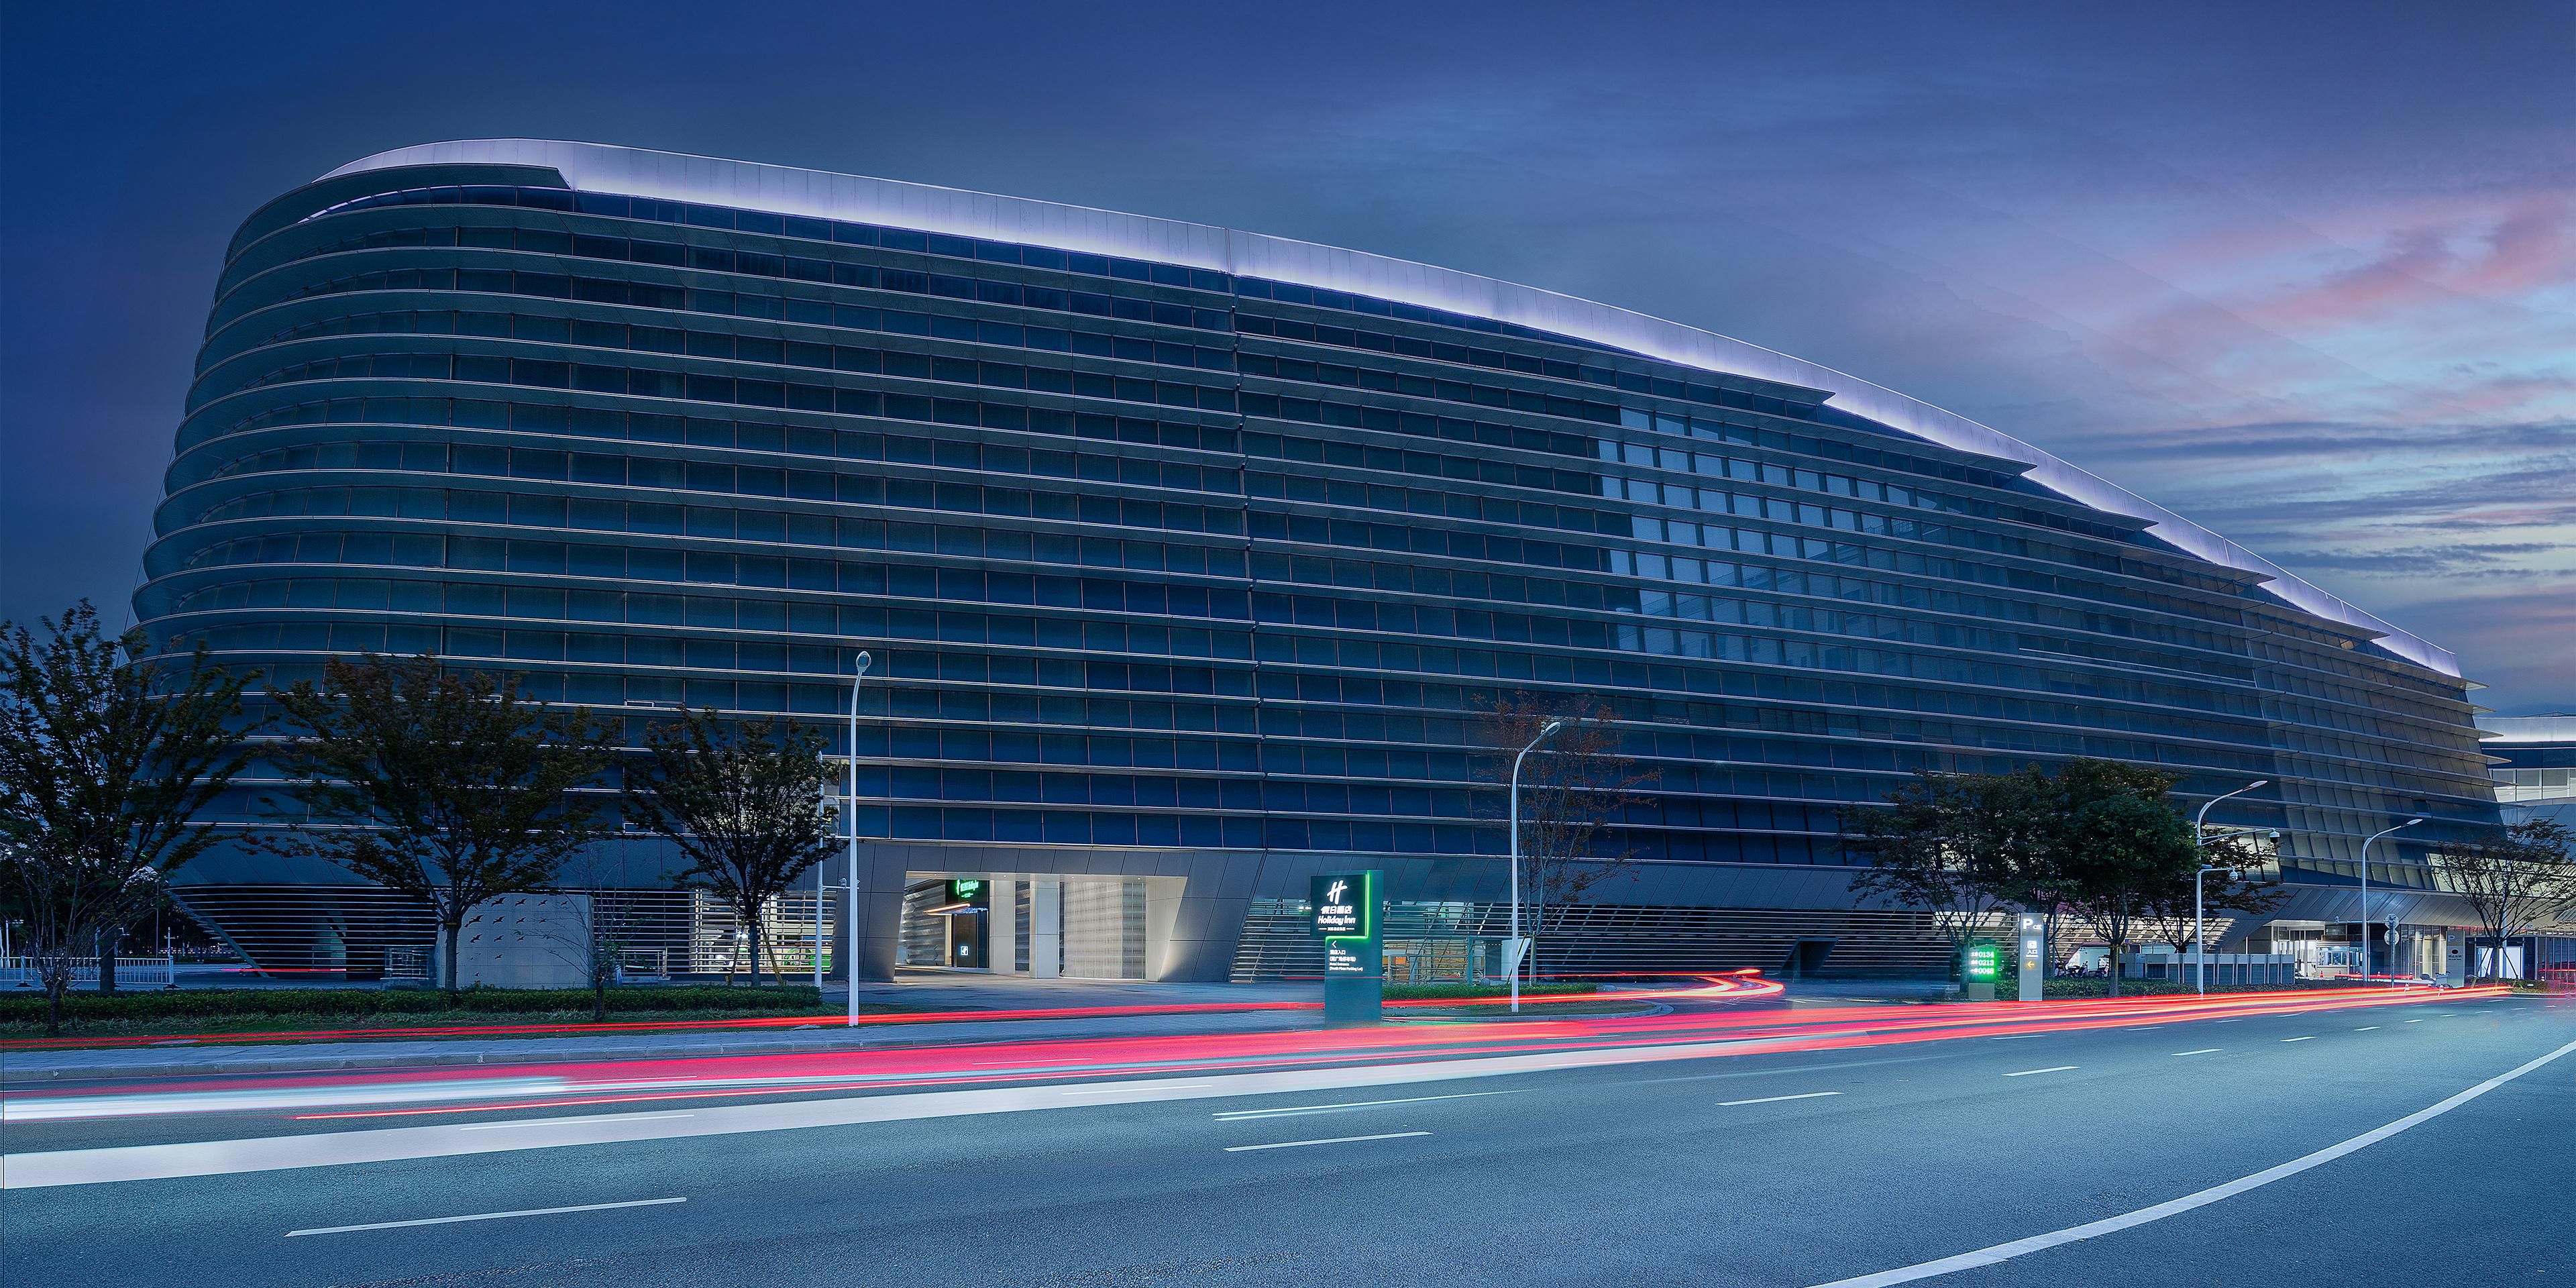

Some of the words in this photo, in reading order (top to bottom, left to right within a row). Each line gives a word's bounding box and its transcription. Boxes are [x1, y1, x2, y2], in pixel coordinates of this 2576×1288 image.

[1318, 915, 1344, 926] Holiday
[1344, 915, 1356, 924] Inn
[2023, 918, 2033, 930] P
